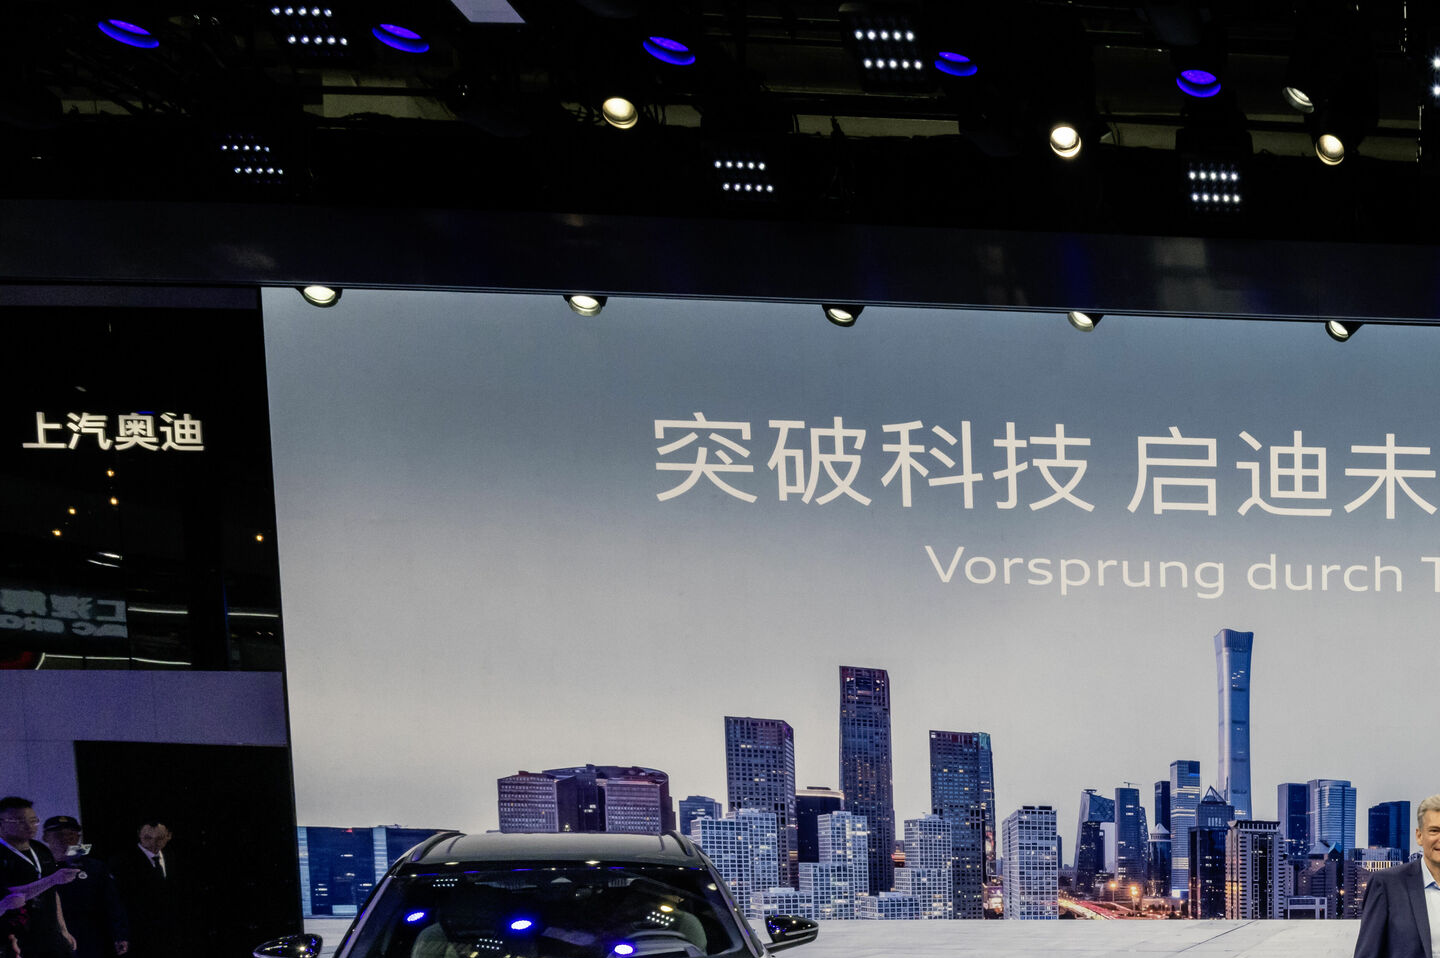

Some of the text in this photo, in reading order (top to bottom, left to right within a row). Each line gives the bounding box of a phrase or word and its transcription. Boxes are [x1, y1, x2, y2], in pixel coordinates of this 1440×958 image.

[22, 411, 205, 451] 上汽奥迪
[653, 411, 1096, 513] 突破科技
[924, 545, 1225, 600] Vorsprung
[1246, 553, 1404, 593] durch
